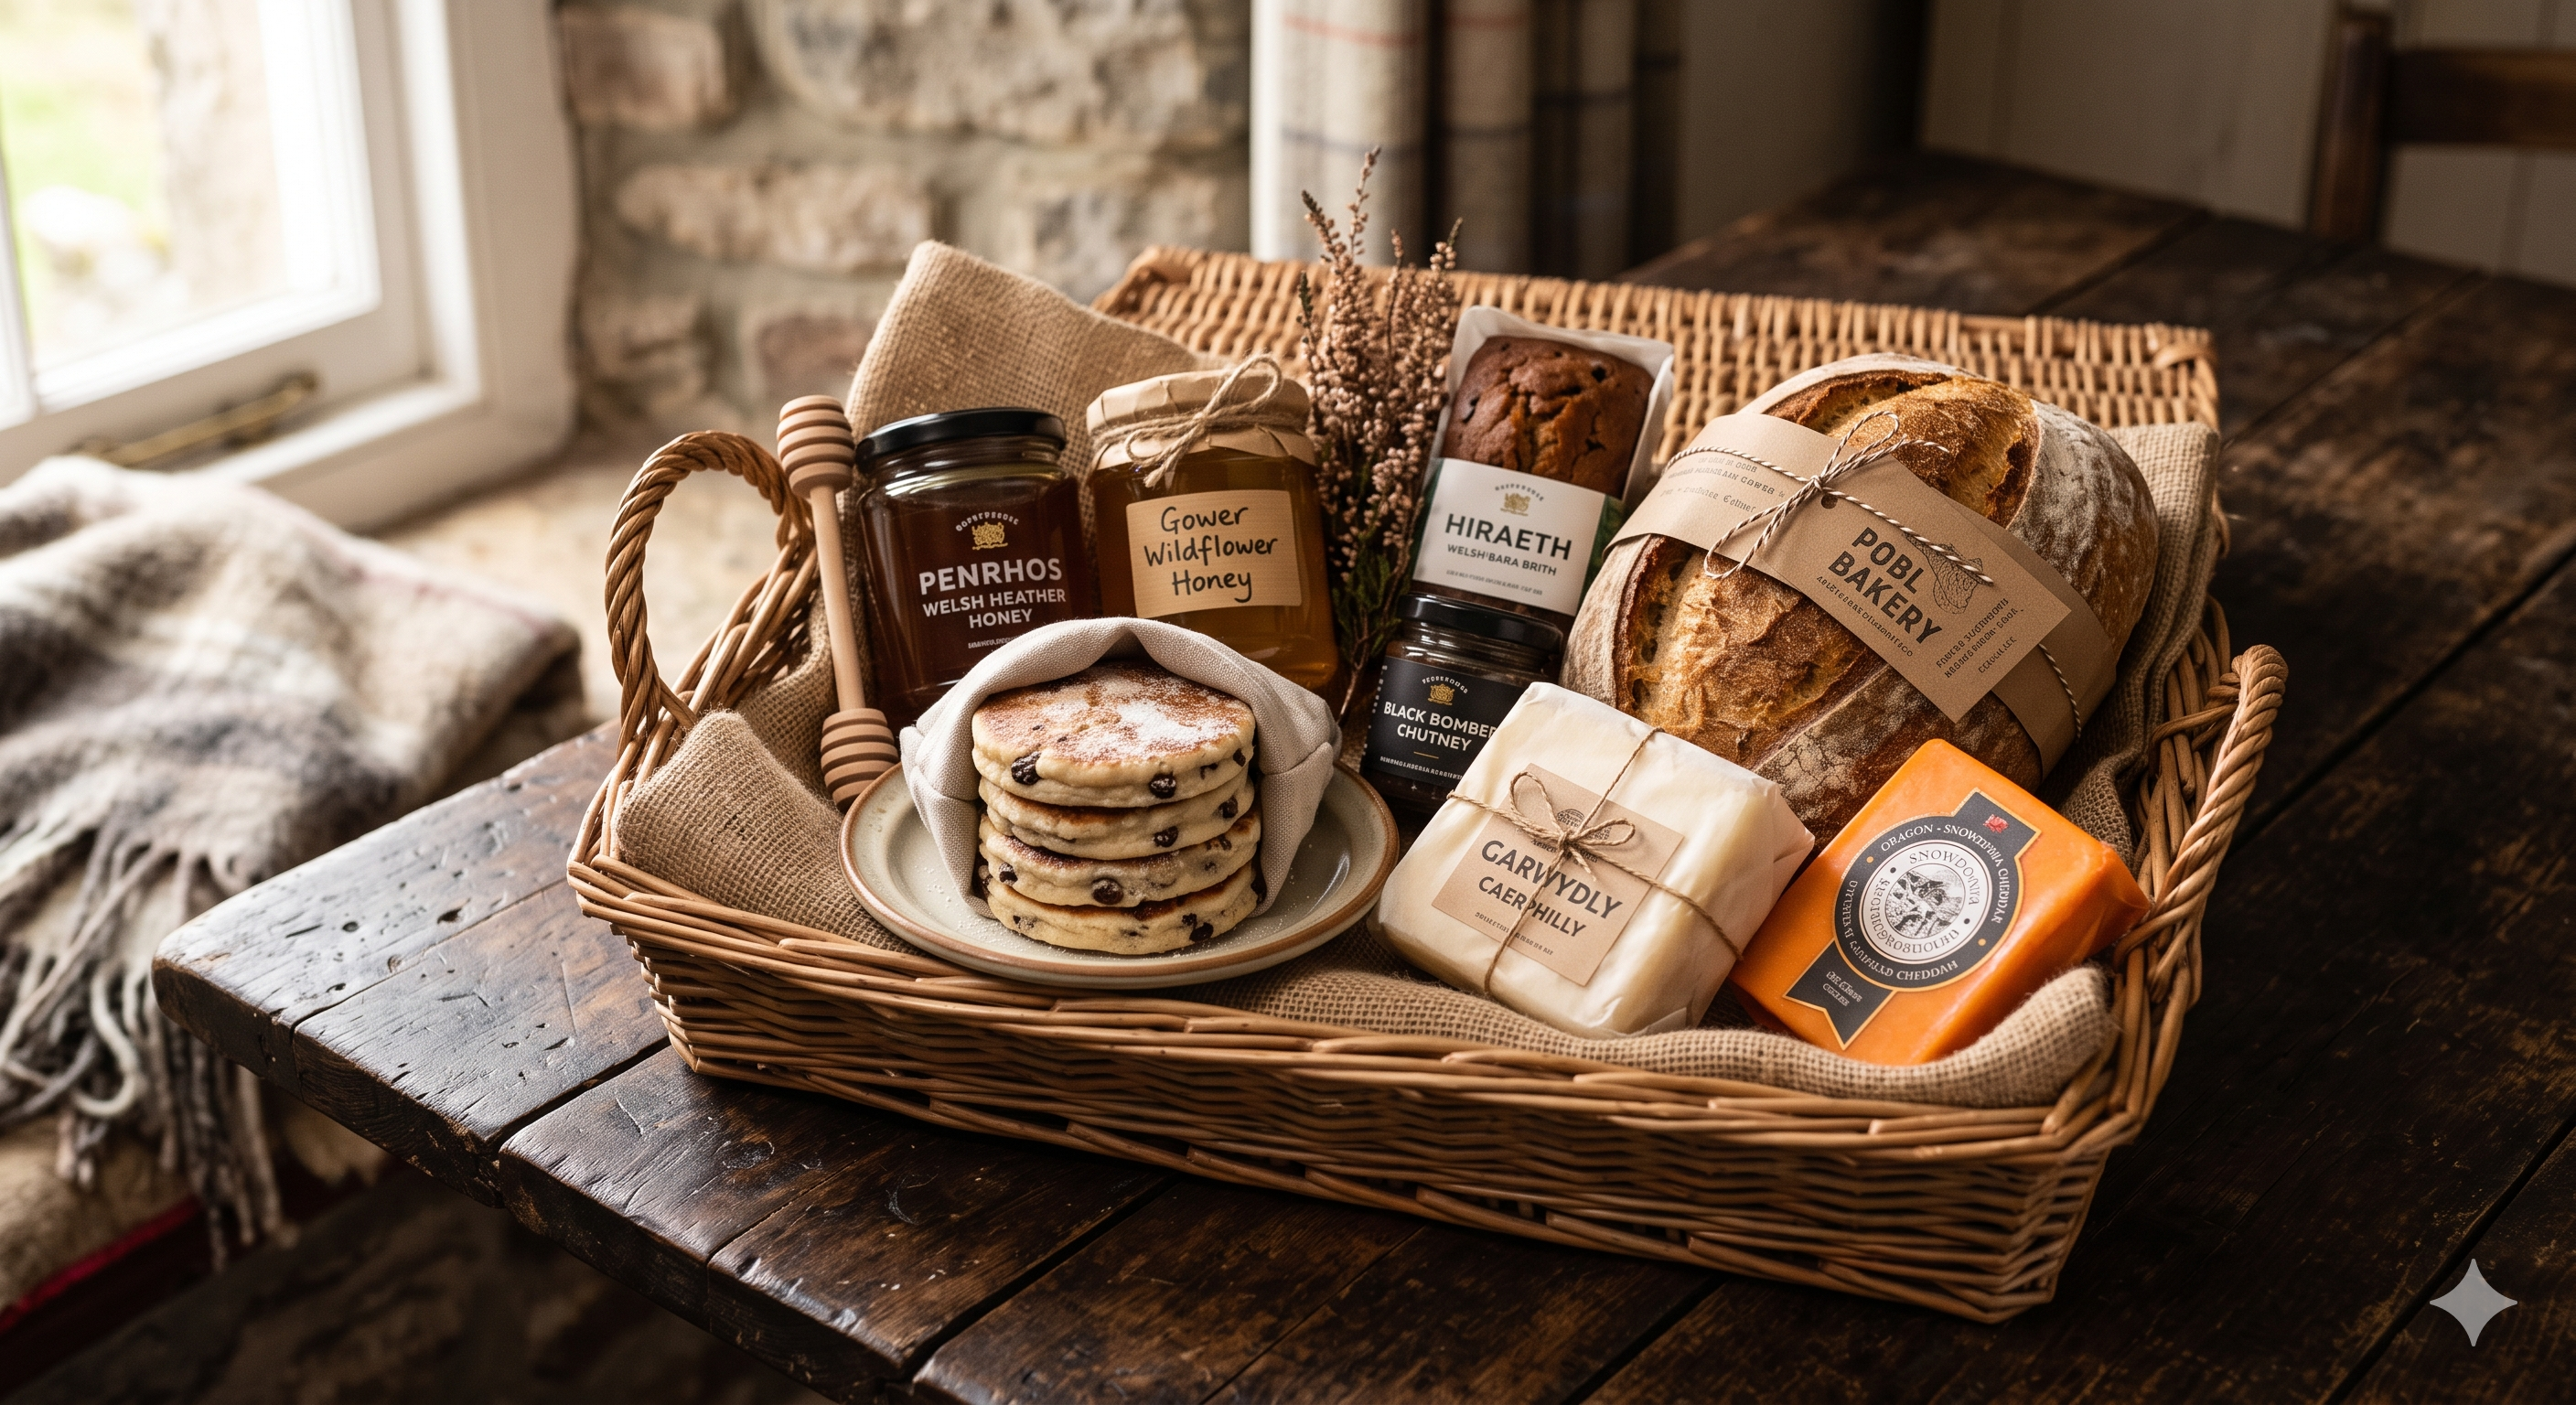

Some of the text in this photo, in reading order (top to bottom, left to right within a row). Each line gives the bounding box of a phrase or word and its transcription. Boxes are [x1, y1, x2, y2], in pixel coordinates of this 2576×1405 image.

[1160, 506, 1250, 535] Gower
[1444, 513, 1572, 561] HIRAETH
[1143, 534, 1279, 567] Wildflower
[1852, 526, 1927, 595] POBL
[918, 558, 1063, 595] PENRHOS
[1521, 560, 1558, 576] BRITH
[922, 588, 1067, 617] WELSH HEATHER
[1171, 569, 1253, 604] Honey
[1827, 551, 1944, 645] BAKERY
[968, 608, 1034, 629] HONEY
[1383, 701, 1427, 724] BLACK
[1397, 724, 1473, 751] CHUTNEY
[1481, 840, 1624, 920] GARWYDLY
